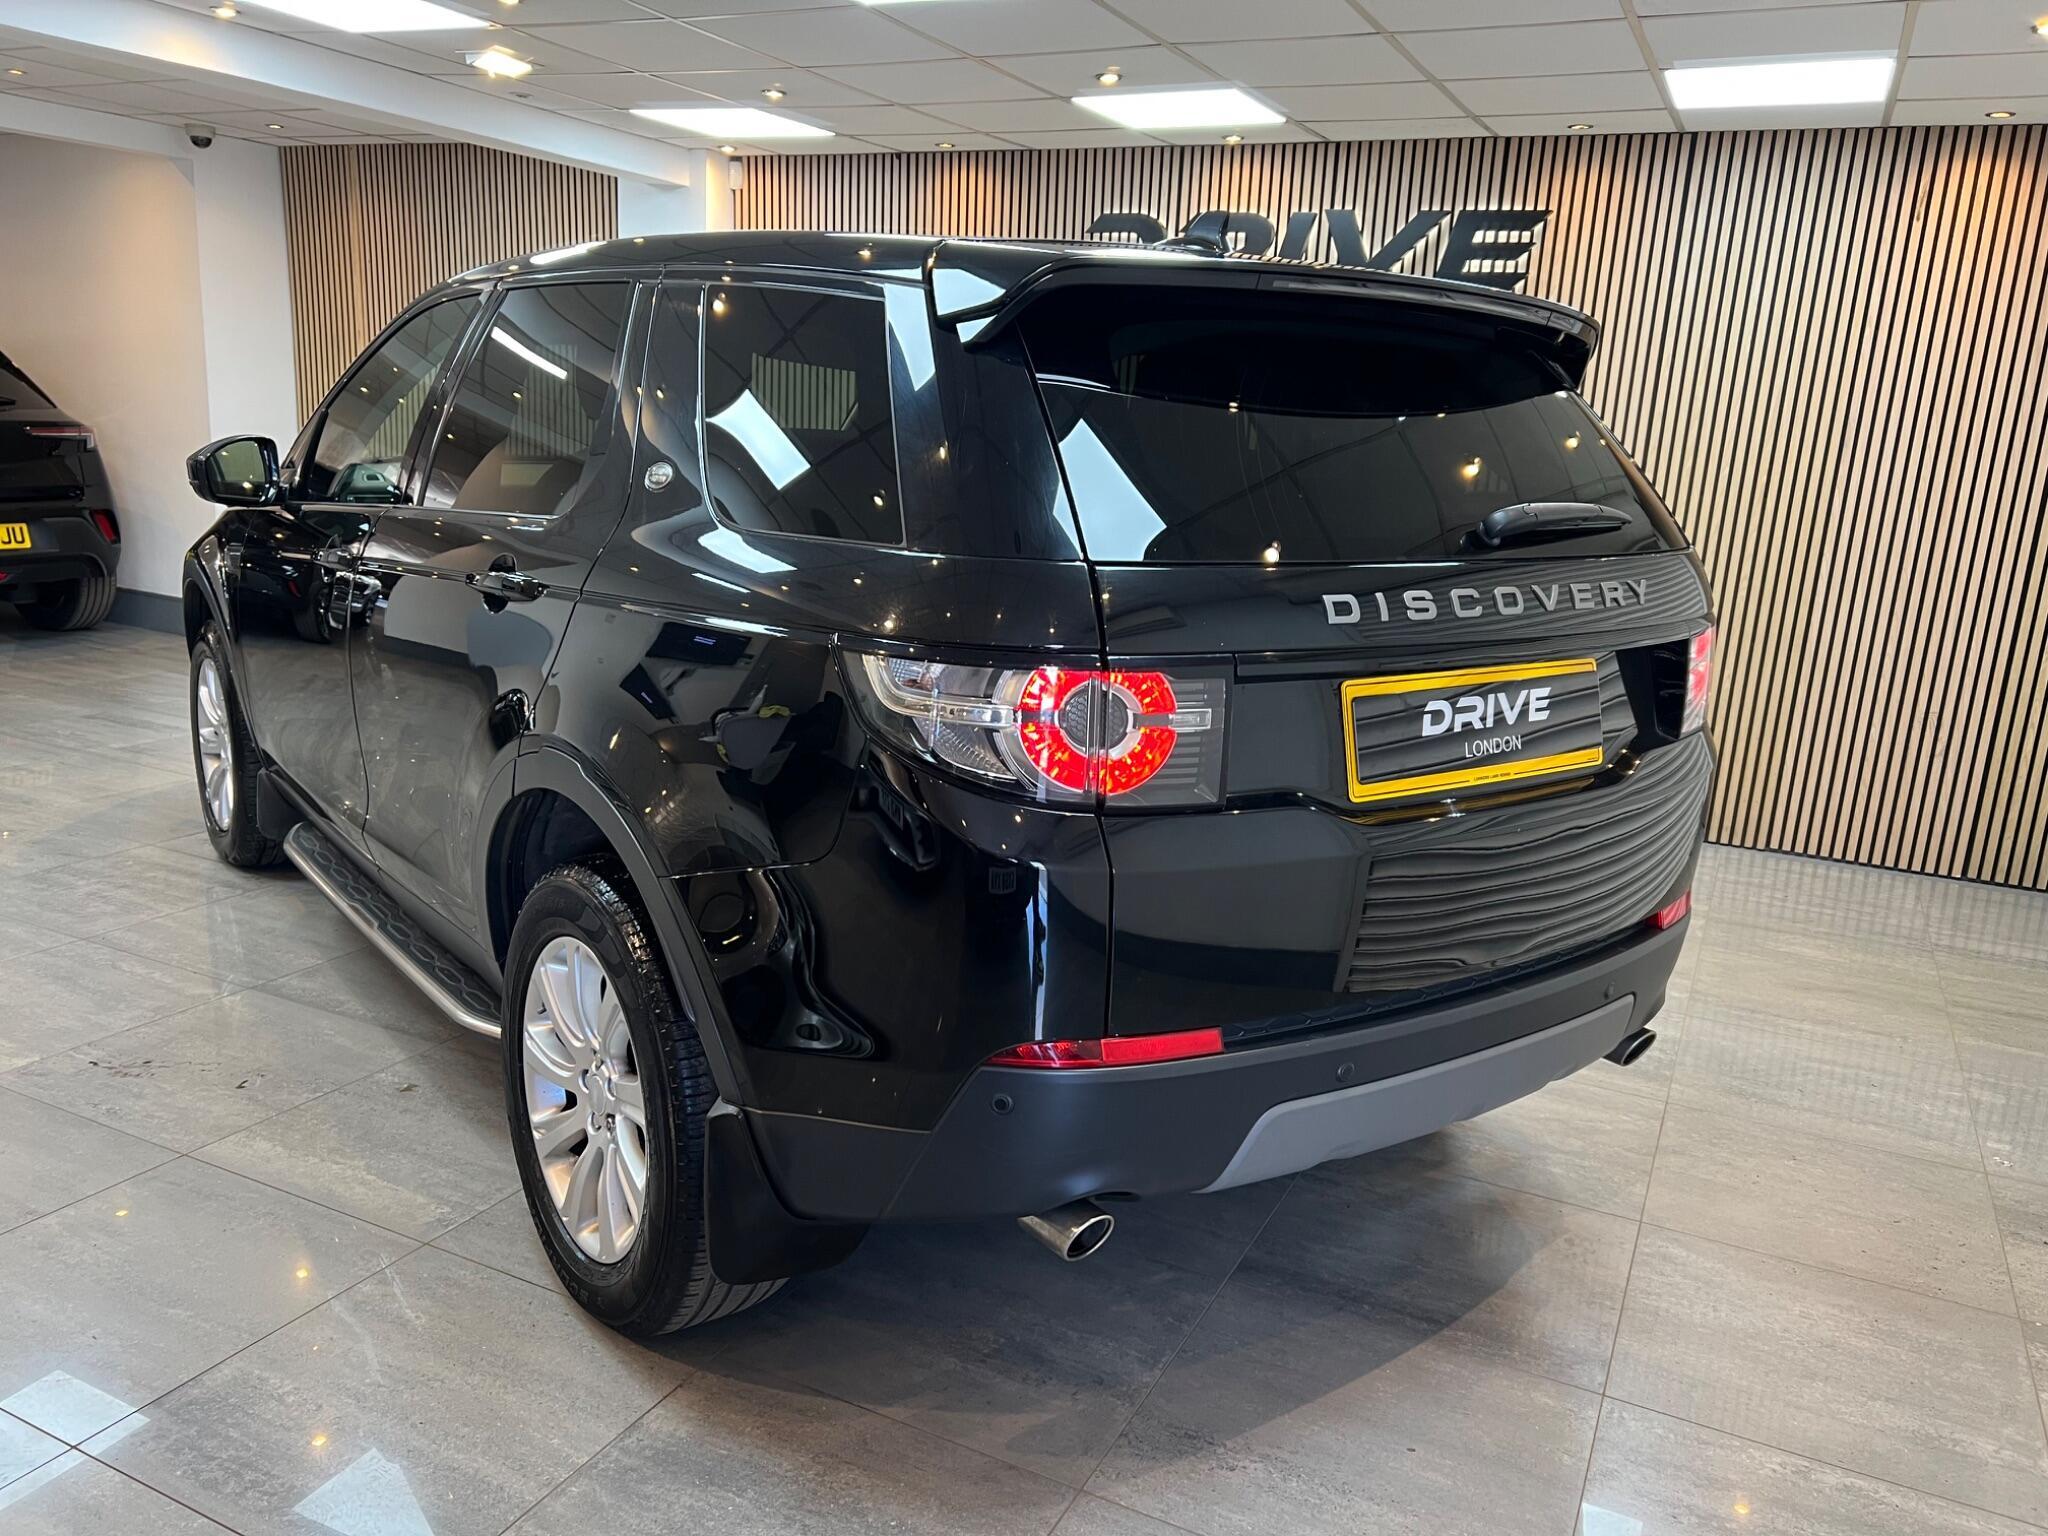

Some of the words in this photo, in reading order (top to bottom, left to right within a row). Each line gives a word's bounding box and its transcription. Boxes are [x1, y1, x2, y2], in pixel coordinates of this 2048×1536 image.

[1322, 579, 1648, 625] DISCOVERY
[1421, 686, 1551, 737] DRIVE
[1464, 734, 1522, 758] LONDON
